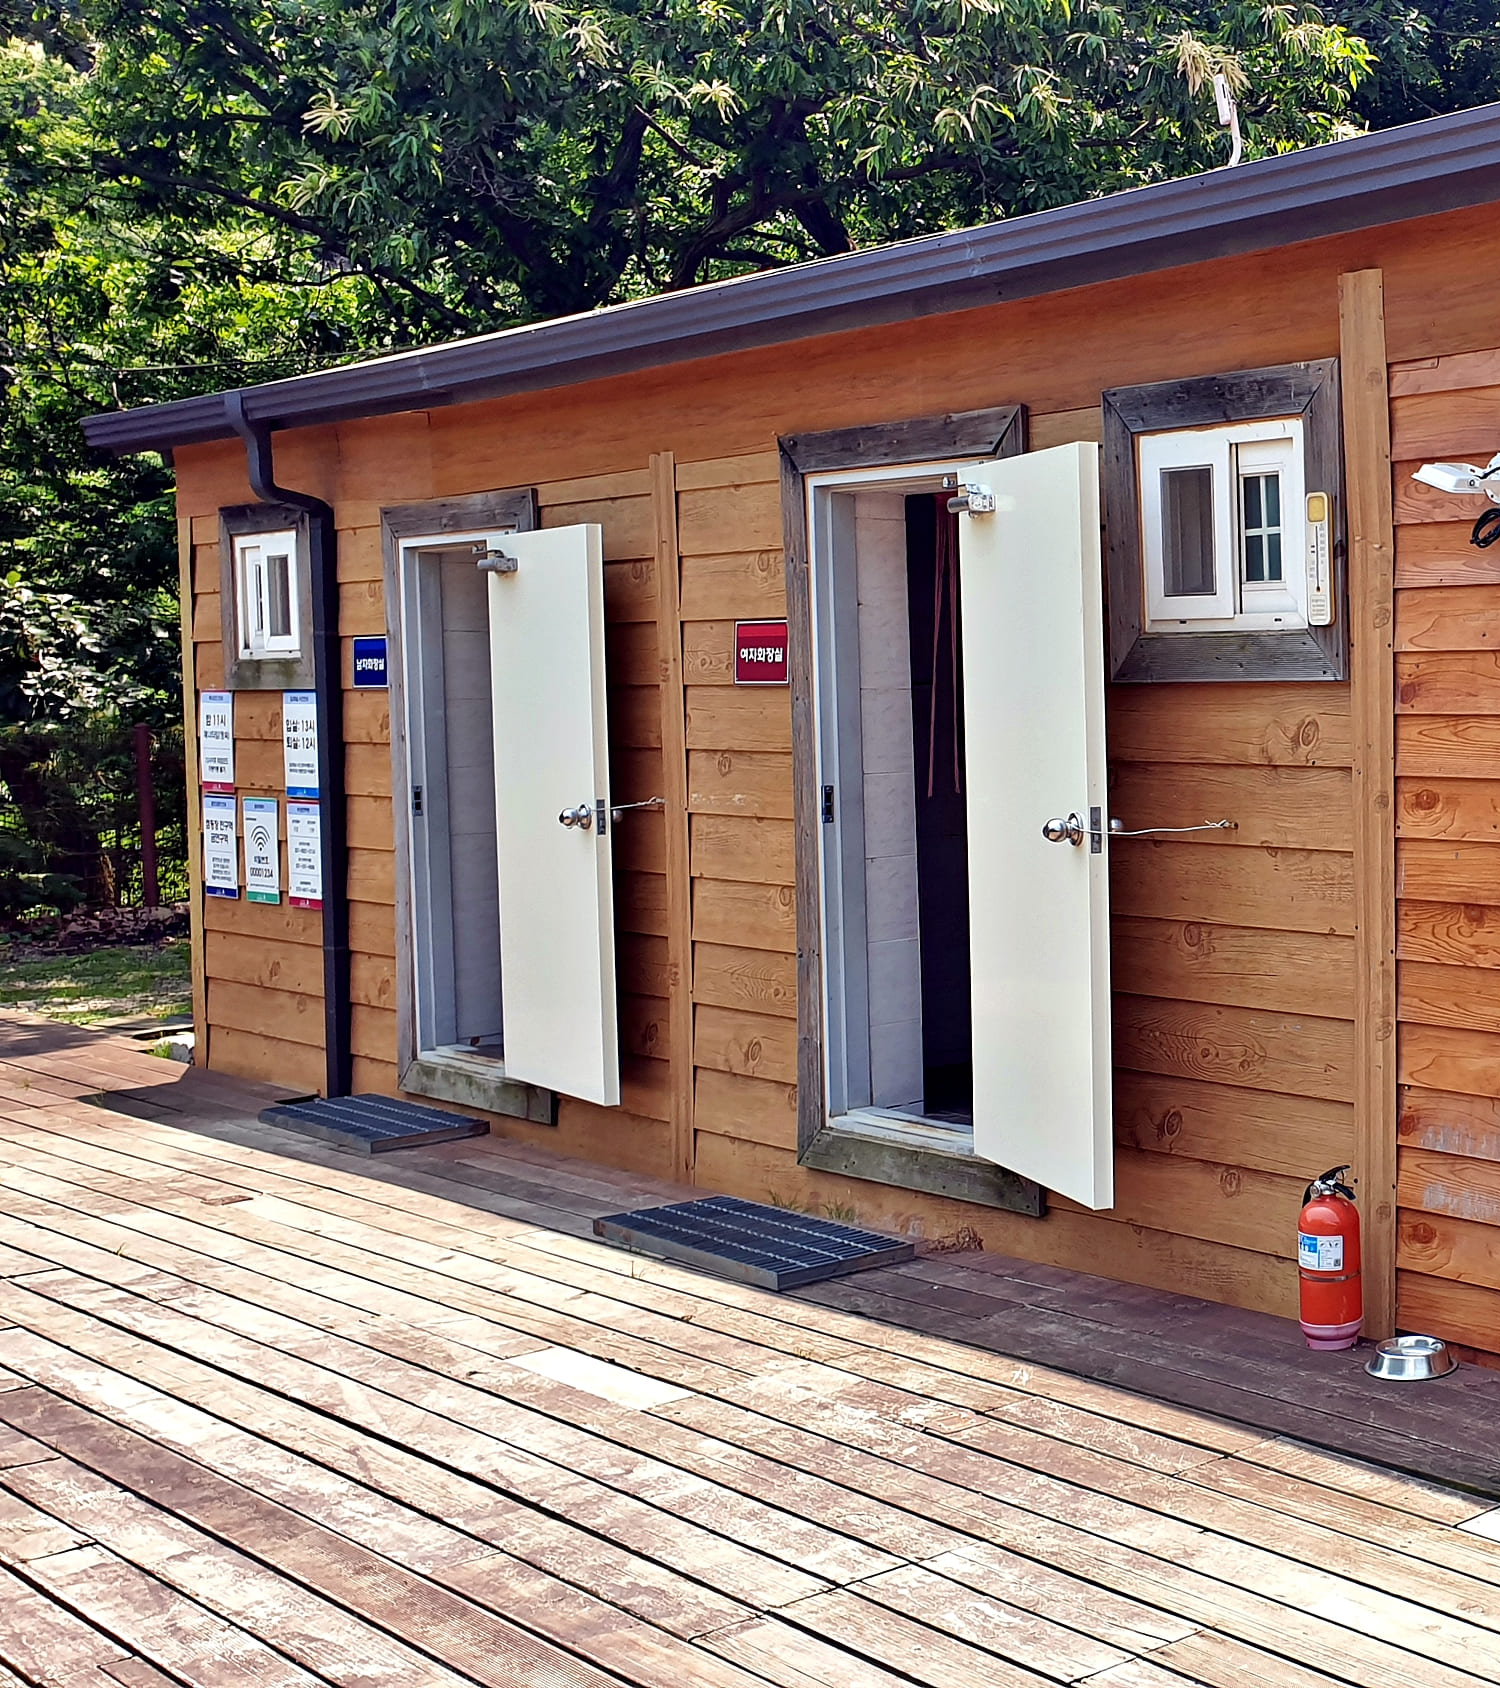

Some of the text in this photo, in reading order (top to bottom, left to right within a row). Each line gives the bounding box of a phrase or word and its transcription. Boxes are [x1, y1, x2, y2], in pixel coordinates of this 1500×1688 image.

[740, 646, 783, 663] 여자화장실
[356, 657, 385, 671] 남자화장실
[213, 714, 227, 727] 11시
[301, 719, 315, 734] 13시
[301, 736, 316, 751] 12시
